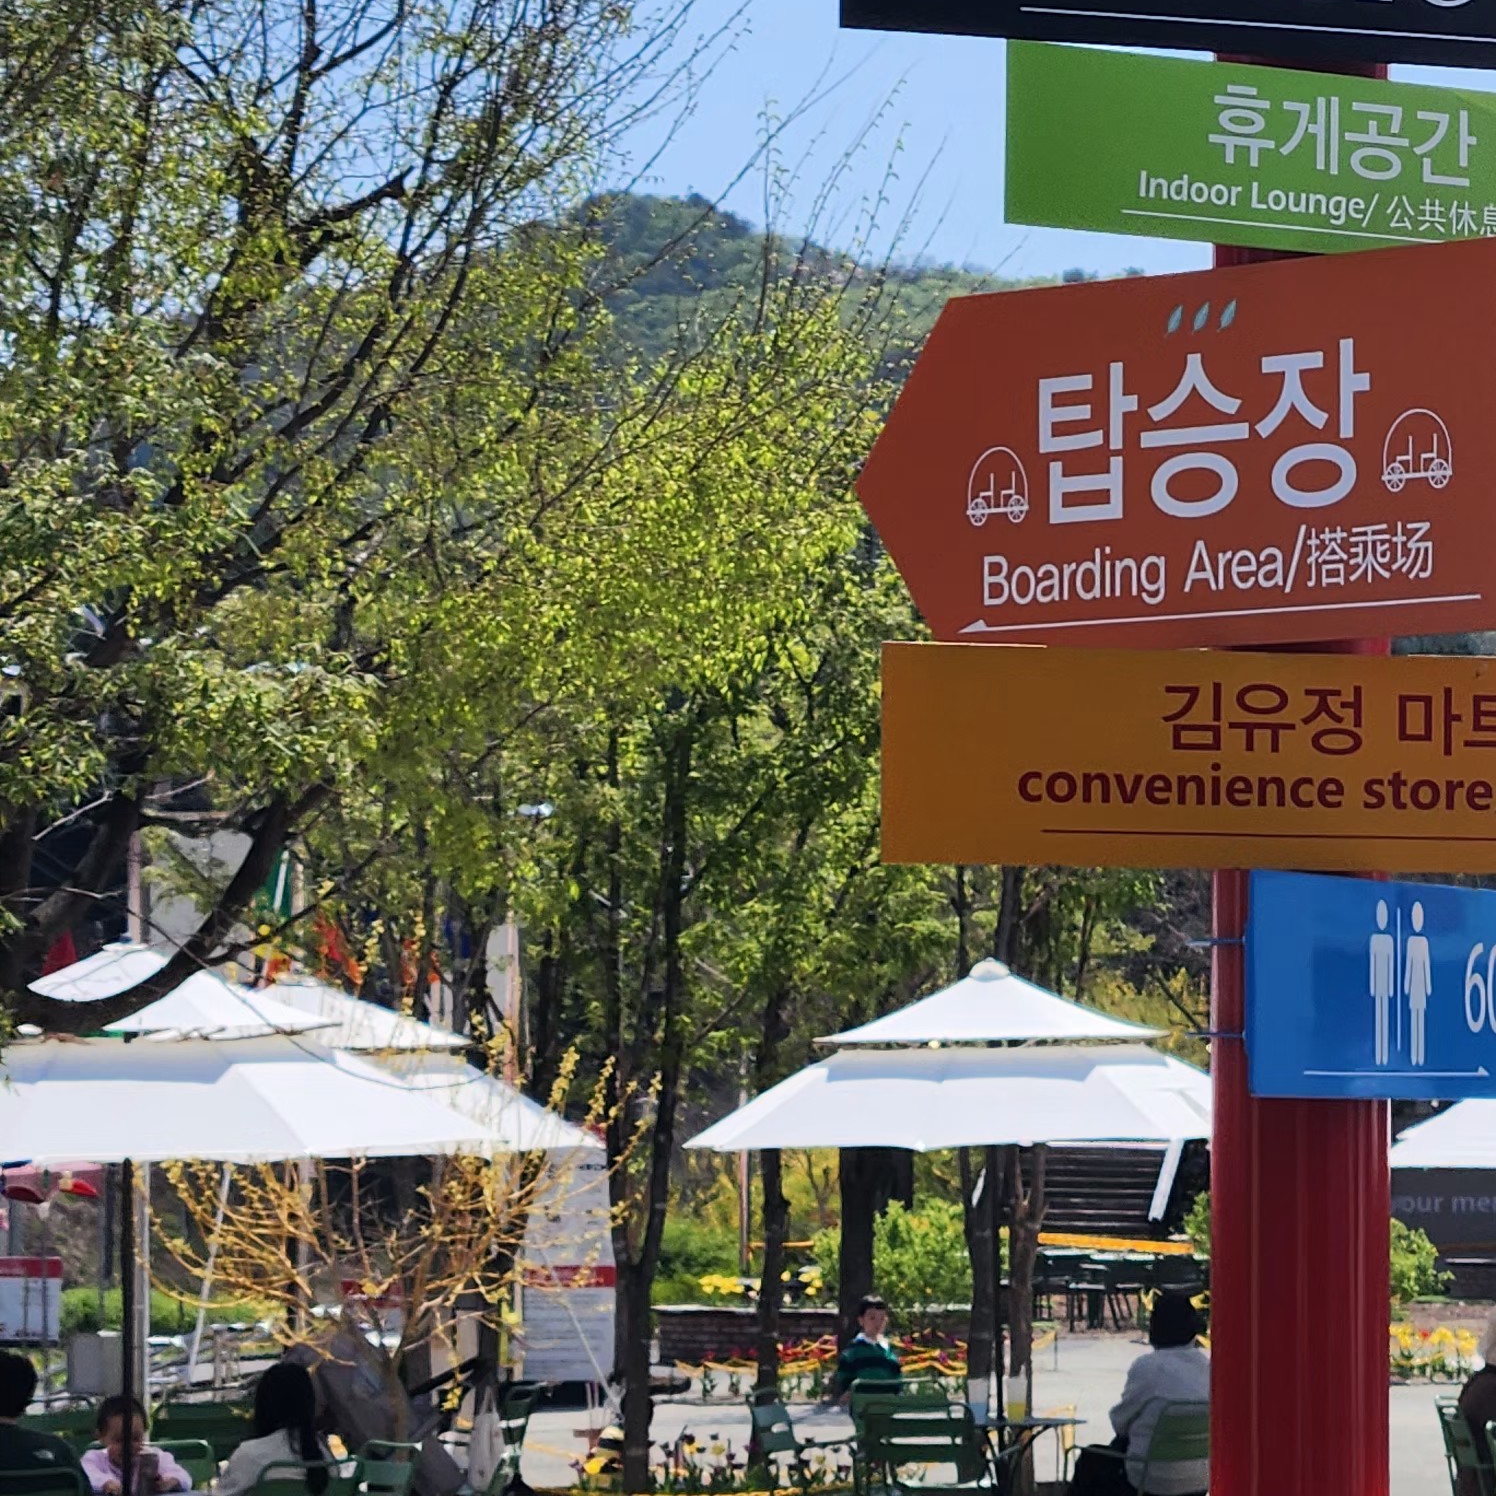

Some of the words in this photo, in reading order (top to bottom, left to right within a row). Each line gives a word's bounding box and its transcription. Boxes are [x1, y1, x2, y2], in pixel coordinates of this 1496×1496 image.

[1208, 84, 1477, 187] 휴게공간
[1139, 170, 1242, 206] Indoor
[1039, 337, 1370, 524] 탑승장
[982, 546, 1166, 606] Boarding
[1162, 681, 1363, 755] 김유정
[1017, 762, 1345, 809] convenience
